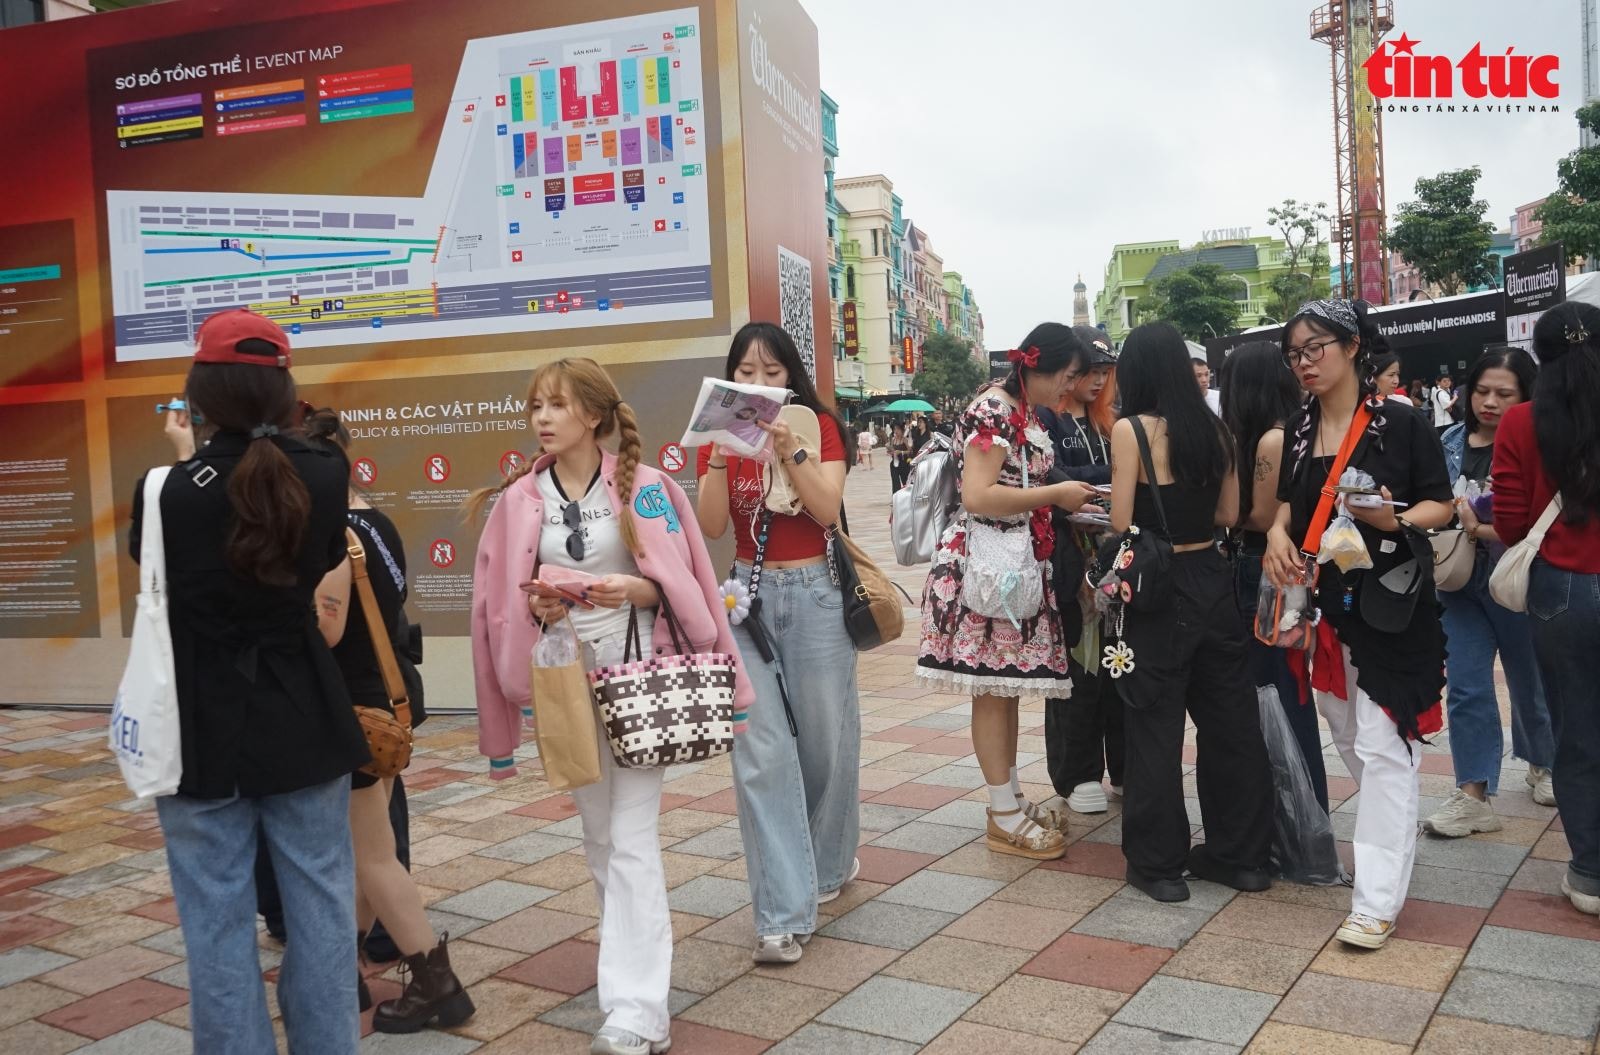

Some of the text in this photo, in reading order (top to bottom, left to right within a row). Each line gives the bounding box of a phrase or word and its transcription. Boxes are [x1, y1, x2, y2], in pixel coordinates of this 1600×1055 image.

[115, 74, 137, 90] SƠ
[138, 67, 162, 87] ĐỒ
[163, 63, 208, 83] TỔNG
[209, 53, 242, 76] THỂ
[255, 50, 307, 70] EVENT
[309, 45, 344, 62] MAP
[1202, 226, 1252, 242] KATINAT
[1506, 262, 1559, 296] Übermensch
[1413, 319, 1433, 334] NIỆM
[1437, 311, 1496, 329] MERCHANDISE
[340, 394, 527, 423] NINH & CÁC VẬT PHẨM
[350, 419, 527, 439] OLICY & PROHIBITED ITEMS
